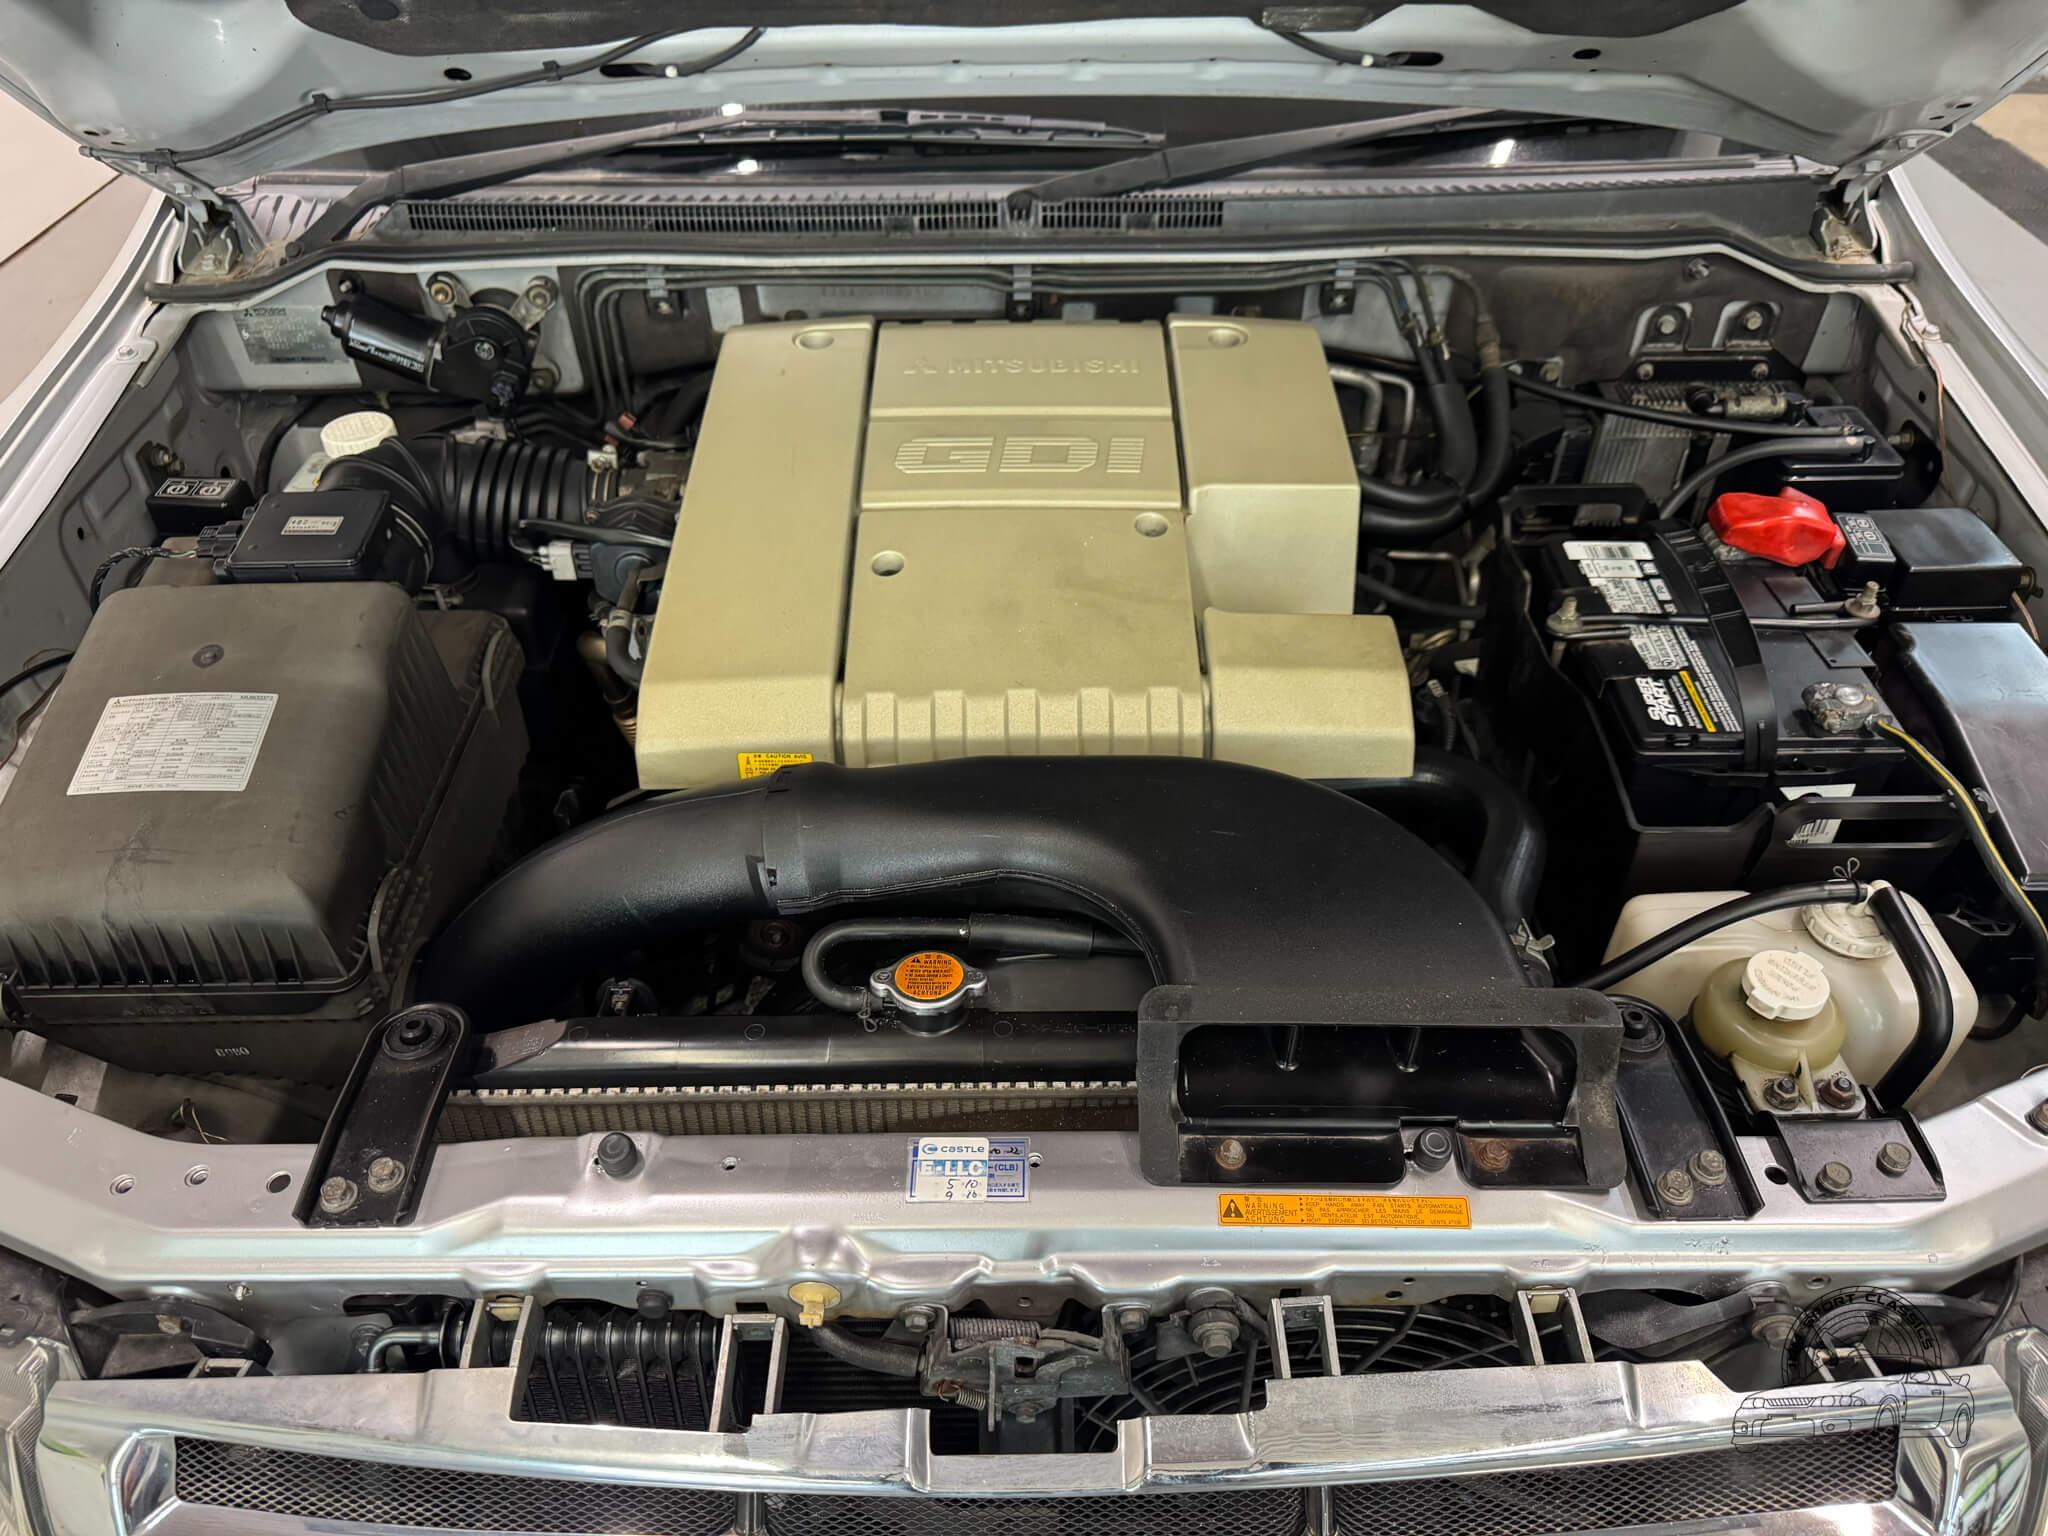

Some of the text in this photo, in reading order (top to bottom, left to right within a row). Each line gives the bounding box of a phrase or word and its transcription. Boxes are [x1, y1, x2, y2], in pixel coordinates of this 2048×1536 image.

[947, 359, 1140, 374] MITSUBISHI
[895, 436, 1145, 473] GDI
[1635, 676, 1665, 721] SUPER
[1649, 678, 1684, 728] START
[1245, 1208, 1298, 1217] AVERTISSEMENT
[1245, 1215, 1286, 1223] ACHTUNG
